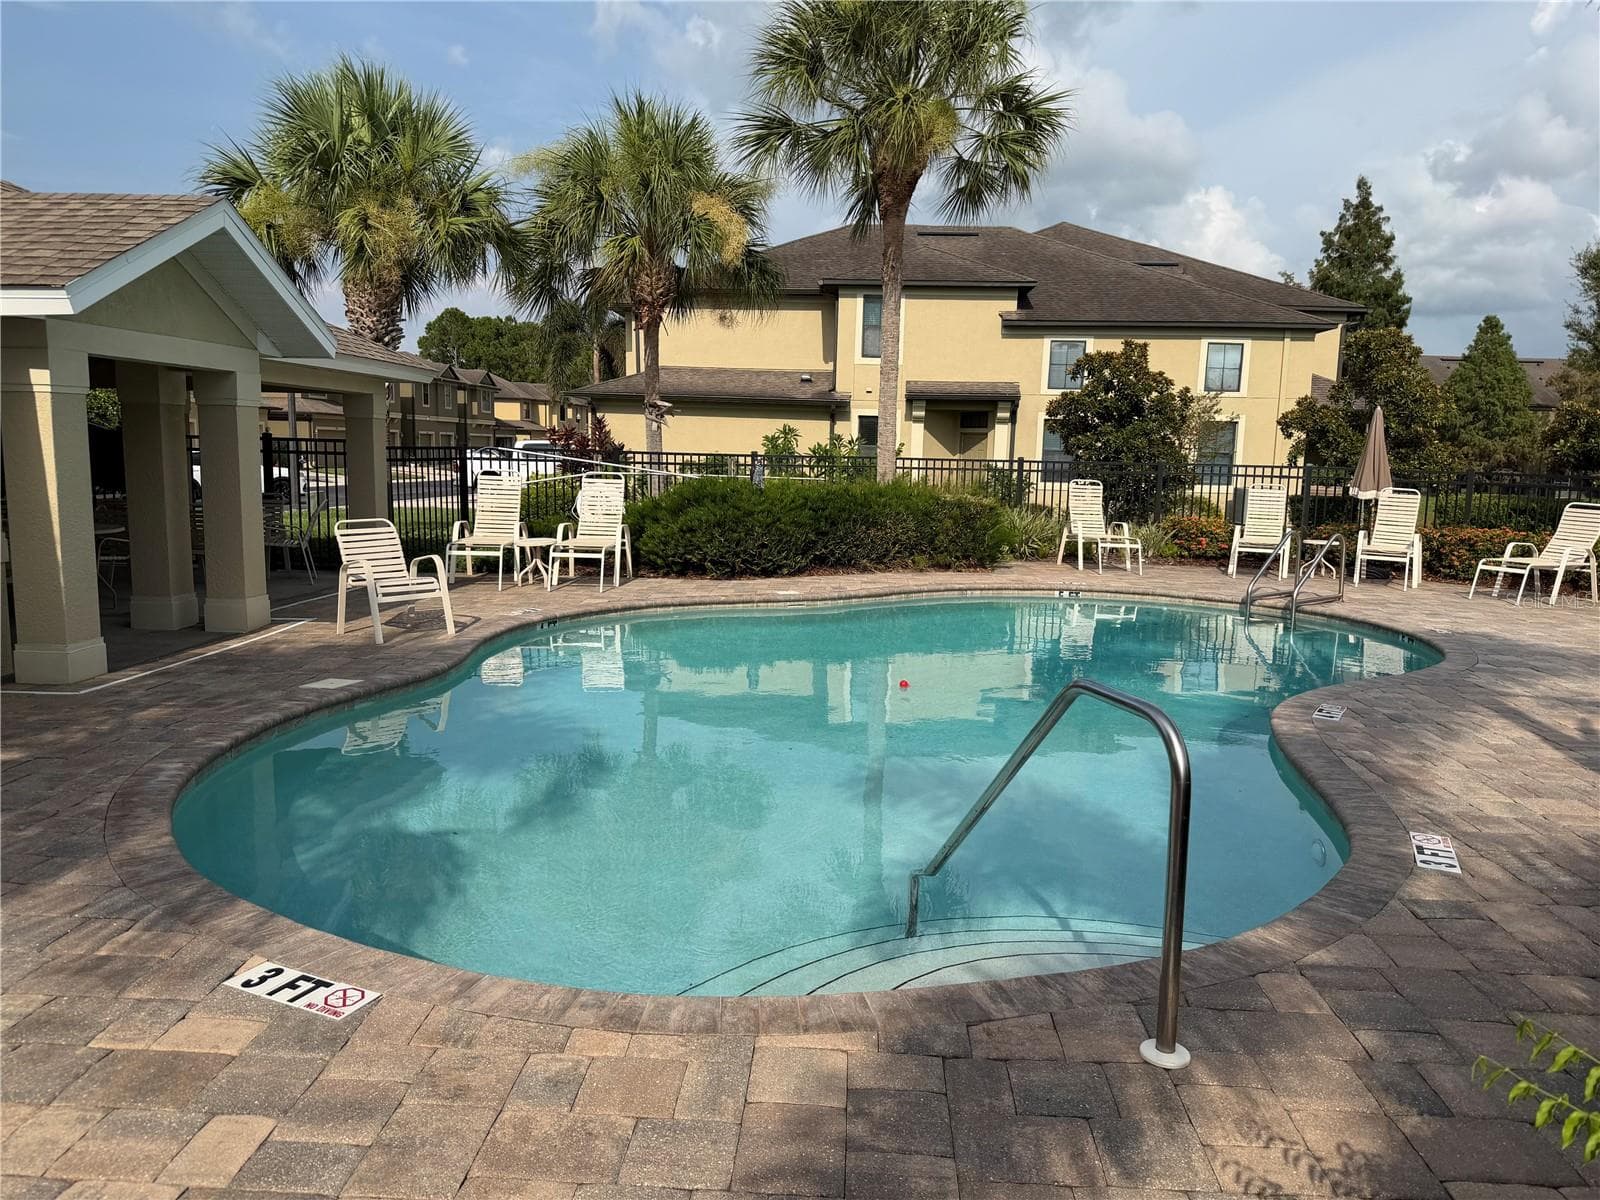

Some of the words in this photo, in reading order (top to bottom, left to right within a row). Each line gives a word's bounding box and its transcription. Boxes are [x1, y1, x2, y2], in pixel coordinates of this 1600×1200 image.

[1415, 845, 1456, 859] FT
[1419, 860, 1457, 868] 3
[240, 967, 285, 988] 3
[265, 974, 335, 1003] FT
[303, 1002, 315, 1010] NO
[316, 1005, 345, 1018] DIVING
